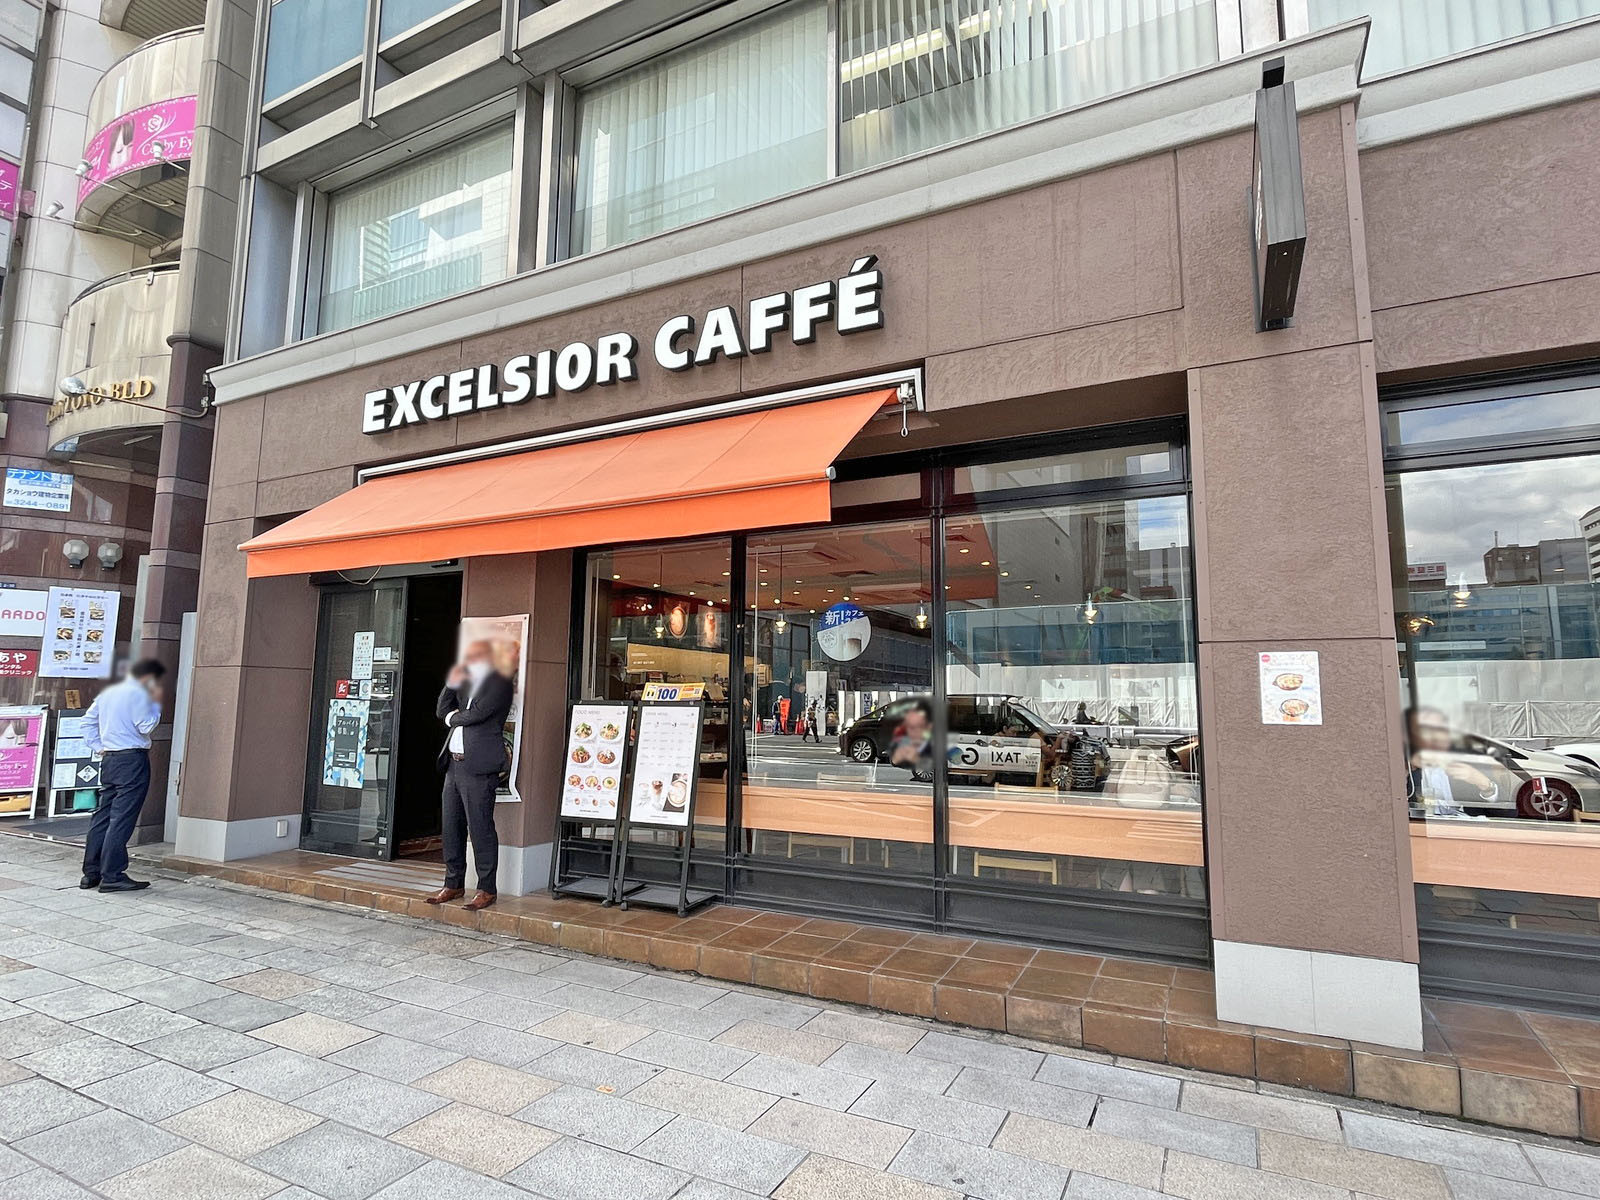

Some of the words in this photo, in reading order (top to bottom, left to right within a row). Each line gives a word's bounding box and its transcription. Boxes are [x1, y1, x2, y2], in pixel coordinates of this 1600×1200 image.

[362, 331, 638, 436] EXCELSIOR
[654, 254, 884, 373] CAFFÉ
[110, 379, 153, 401] BLD
[656, 687, 678, 700] 100
